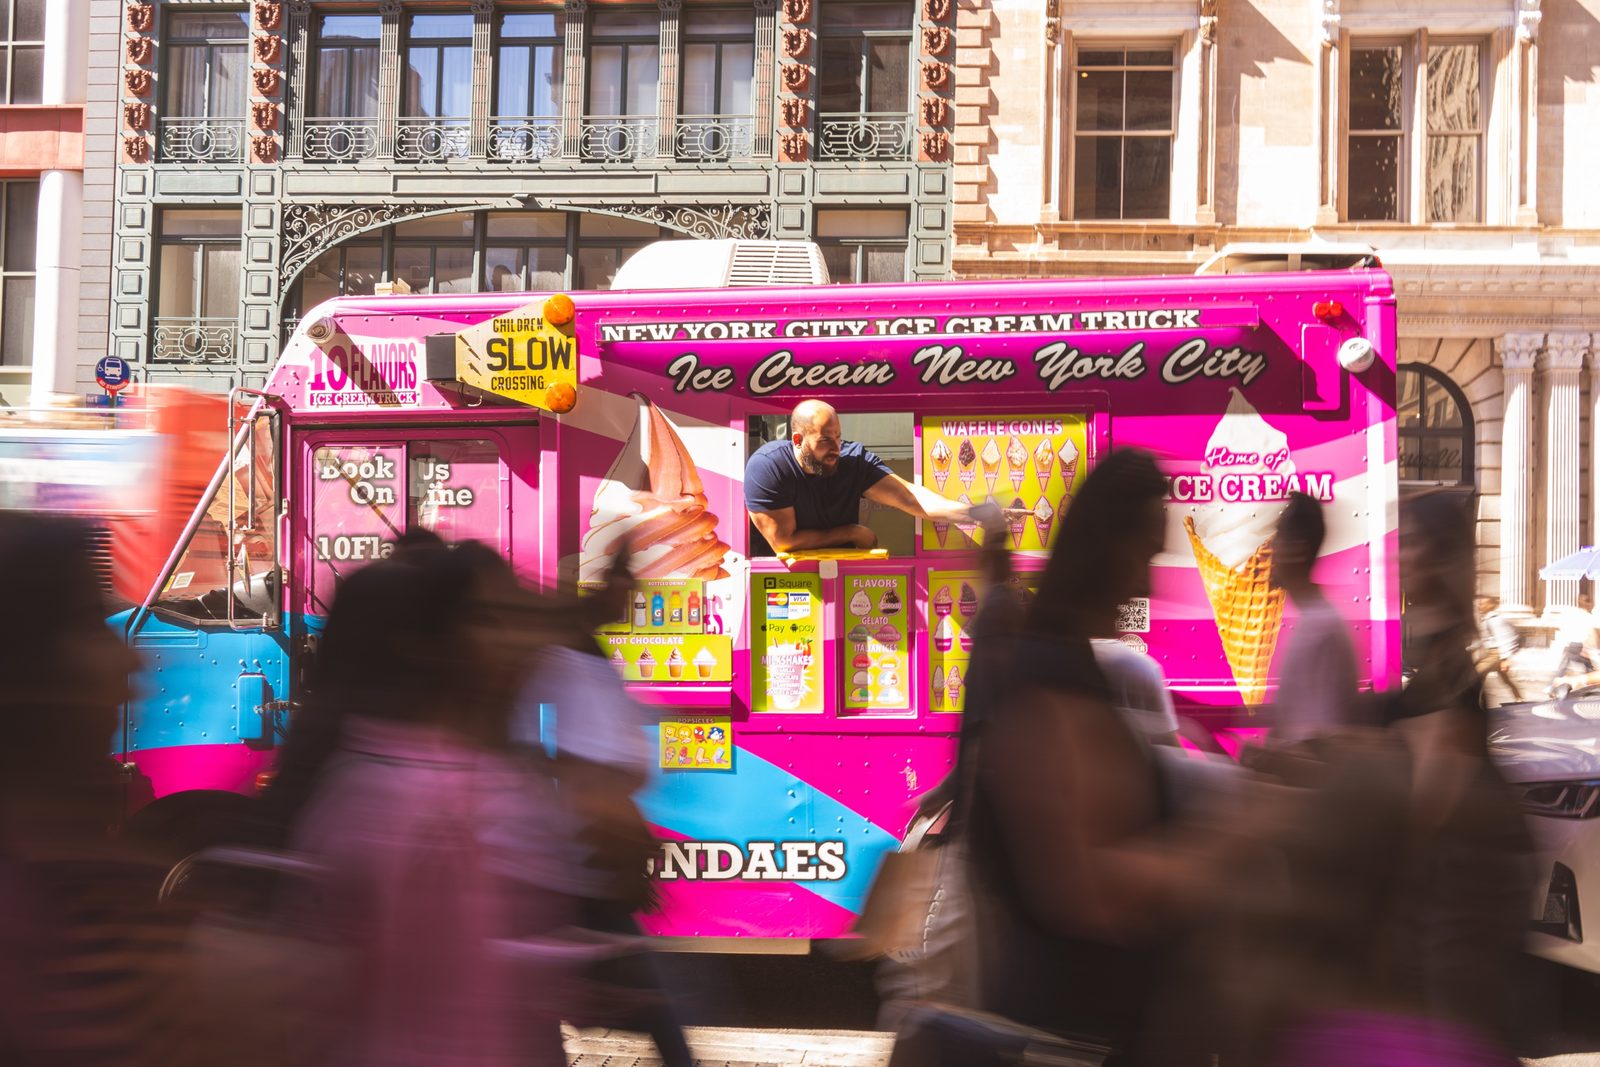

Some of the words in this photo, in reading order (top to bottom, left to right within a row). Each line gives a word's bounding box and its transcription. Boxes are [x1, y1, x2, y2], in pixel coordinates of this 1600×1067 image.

[493, 318, 543, 333] CHILDREN
[602, 324, 678, 341] NEW
[683, 322, 776, 340] YORK
[785, 320, 868, 336] CITY
[876, 318, 935, 335] ICE
[946, 313, 1073, 334] CREAM
[1081, 309, 1200, 330] TRUCK
[486, 336, 572, 371] SLOW
[309, 346, 348, 391] 10
[351, 342, 416, 391] FLAVORS
[668, 354, 734, 392] Ice
[749, 350, 894, 394] Cream
[913, 345, 1015, 385] New
[1035, 342, 1145, 390] York
[1162, 338, 1266, 385] City
[491, 375, 544, 391] CROSSING
[312, 393, 332, 405] ICE
[335, 392, 375, 405] CREAM
[377, 391, 416, 404] TRUCK
[942, 420, 1004, 436] WAFFLE
[1009, 419, 1063, 435] CONES
[321, 456, 394, 479] Book
[1207, 447, 1258, 467] Home
[1265, 448, 1289, 471] of
[351, 481, 394, 504] On
[1220, 473, 1333, 502] CREAM
[778, 579, 812, 589] Square
[853, 578, 898, 588] FLAVORS
[769, 623, 785, 633] Pay
[861, 616, 889, 625] GELATO
[609, 637, 628, 645] HOT
[630, 636, 685, 645] CHOCOLATE
[646, 842, 846, 879] NDAES
